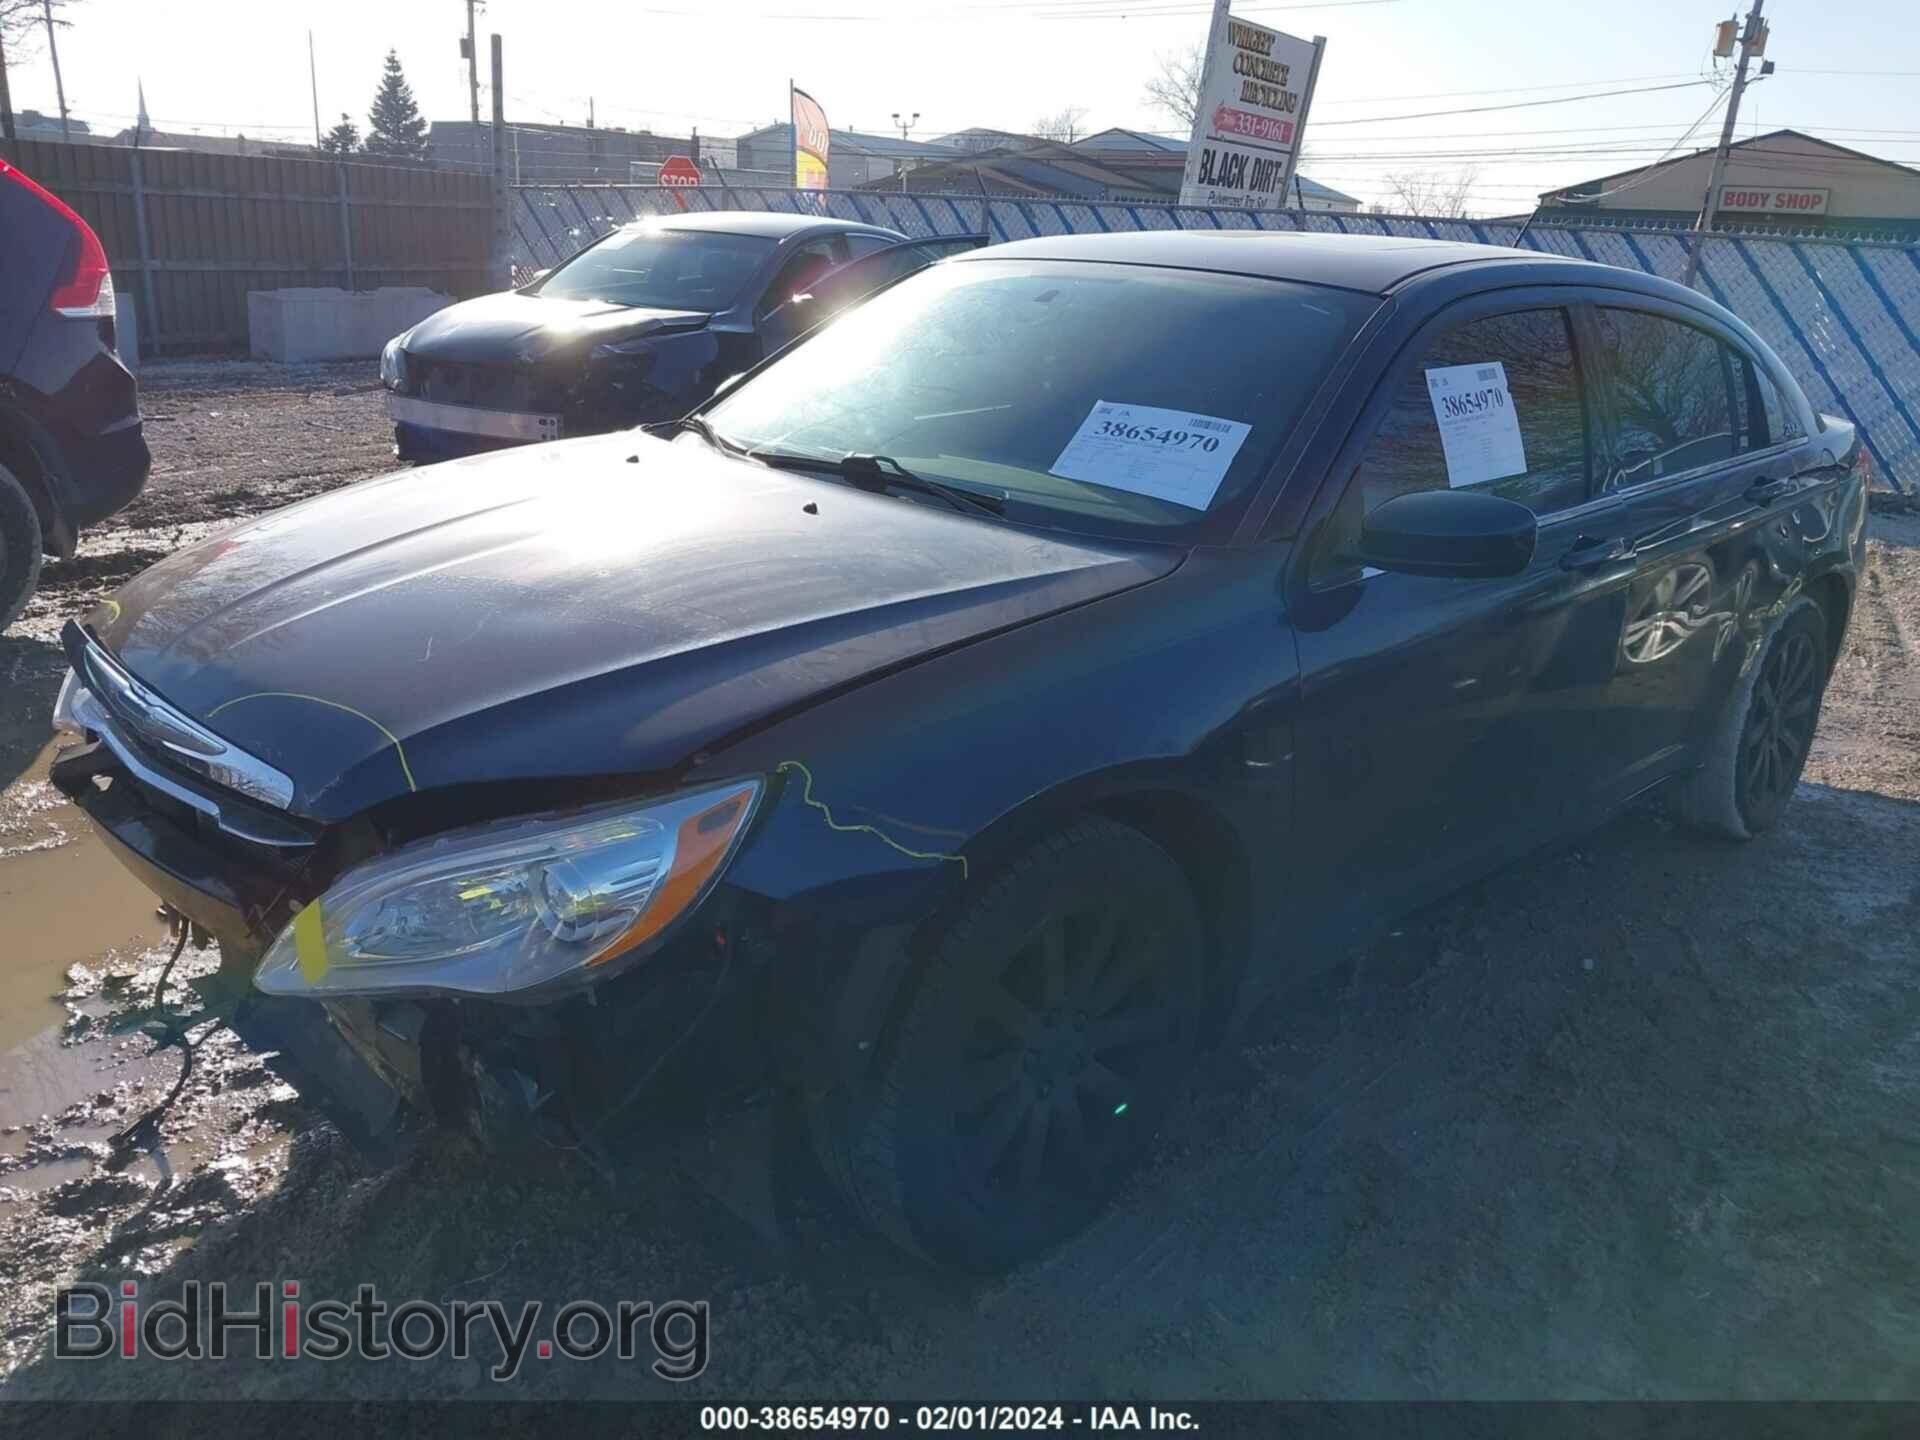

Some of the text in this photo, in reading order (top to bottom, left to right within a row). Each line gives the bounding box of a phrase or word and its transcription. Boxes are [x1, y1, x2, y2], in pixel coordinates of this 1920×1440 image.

[660, 174, 698, 187] STOP
[1198, 149, 1283, 193] BLACK DIRT
[1723, 191, 1824, 210] BODY SHOP
[1441, 387, 1505, 418] 38654970
[1093, 420, 1220, 453] 38654970
